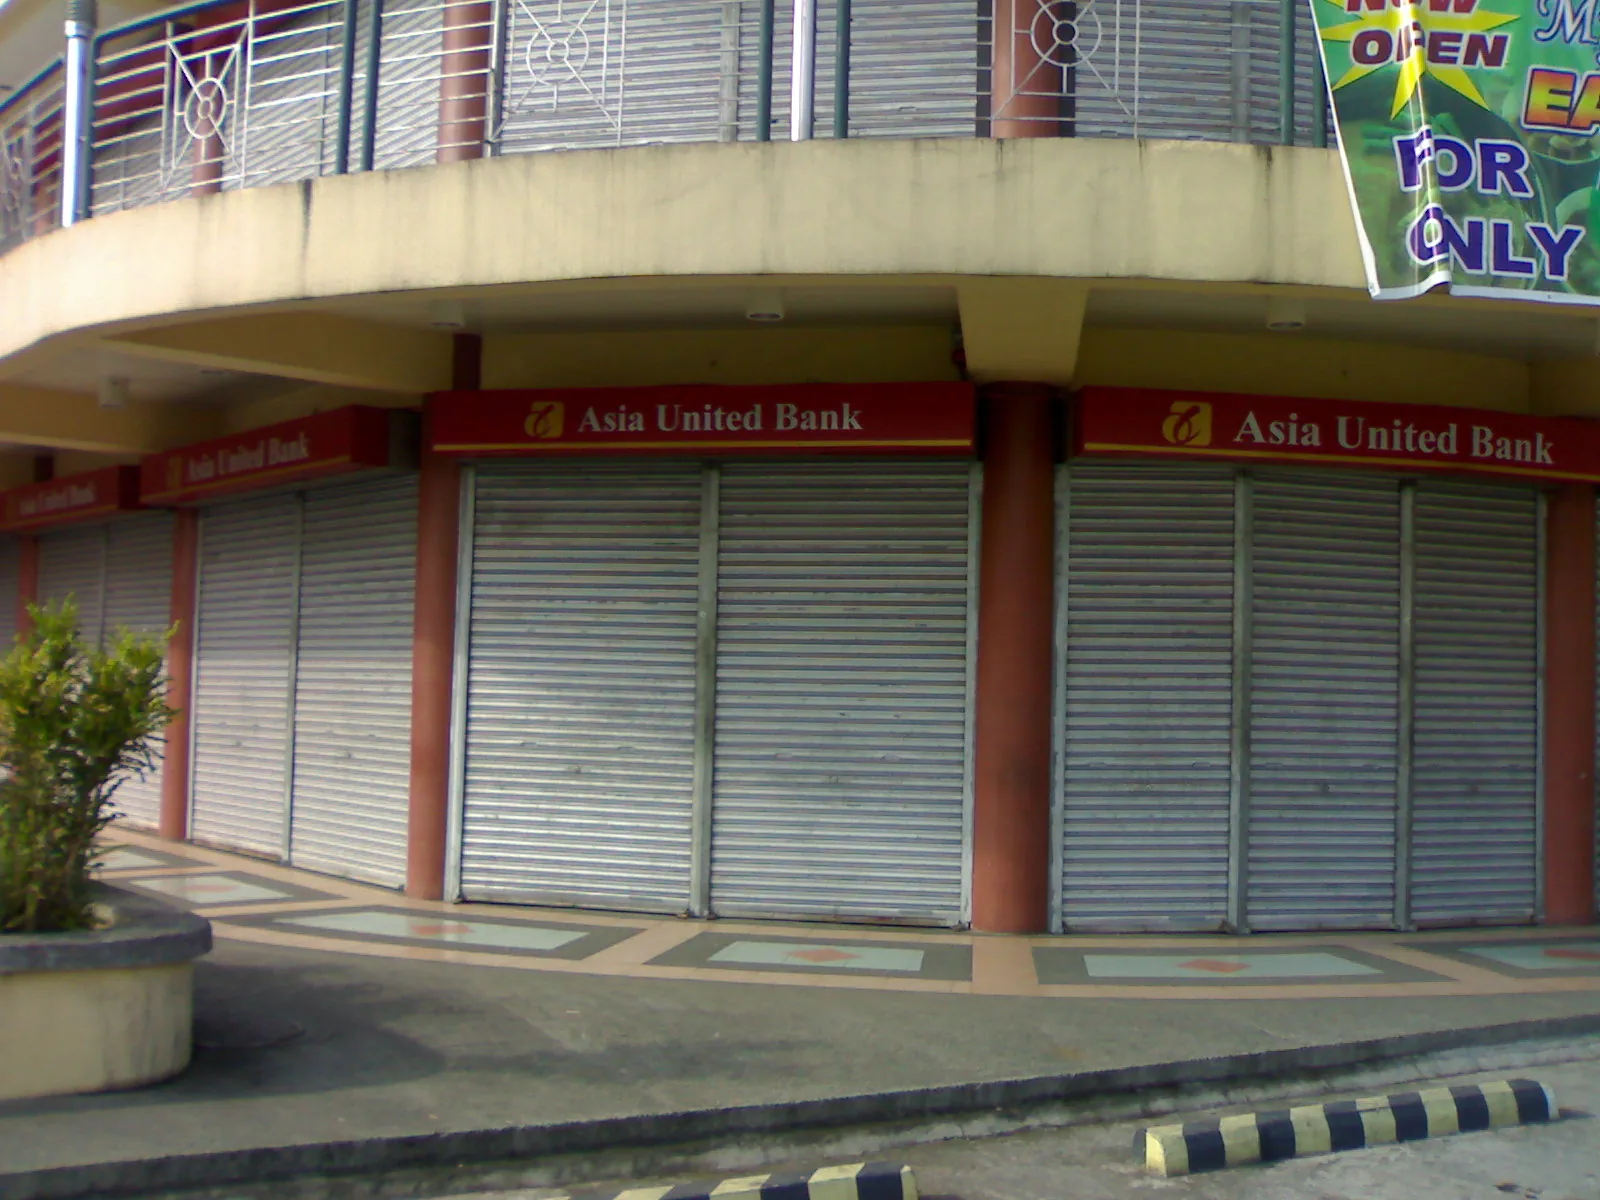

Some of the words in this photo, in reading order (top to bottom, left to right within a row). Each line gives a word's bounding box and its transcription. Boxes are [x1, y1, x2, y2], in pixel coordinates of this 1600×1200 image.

[1351, 22, 1509, 68] OPEN
[1393, 125, 1534, 198] FOR
[1406, 203, 1586, 281] ONLY
[578, 404, 646, 433] Asia
[656, 403, 765, 432] United
[776, 402, 864, 431] Bank
[1233, 409, 1321, 447] Asia
[1336, 414, 1458, 455] United
[1470, 424, 1555, 465] Bank
